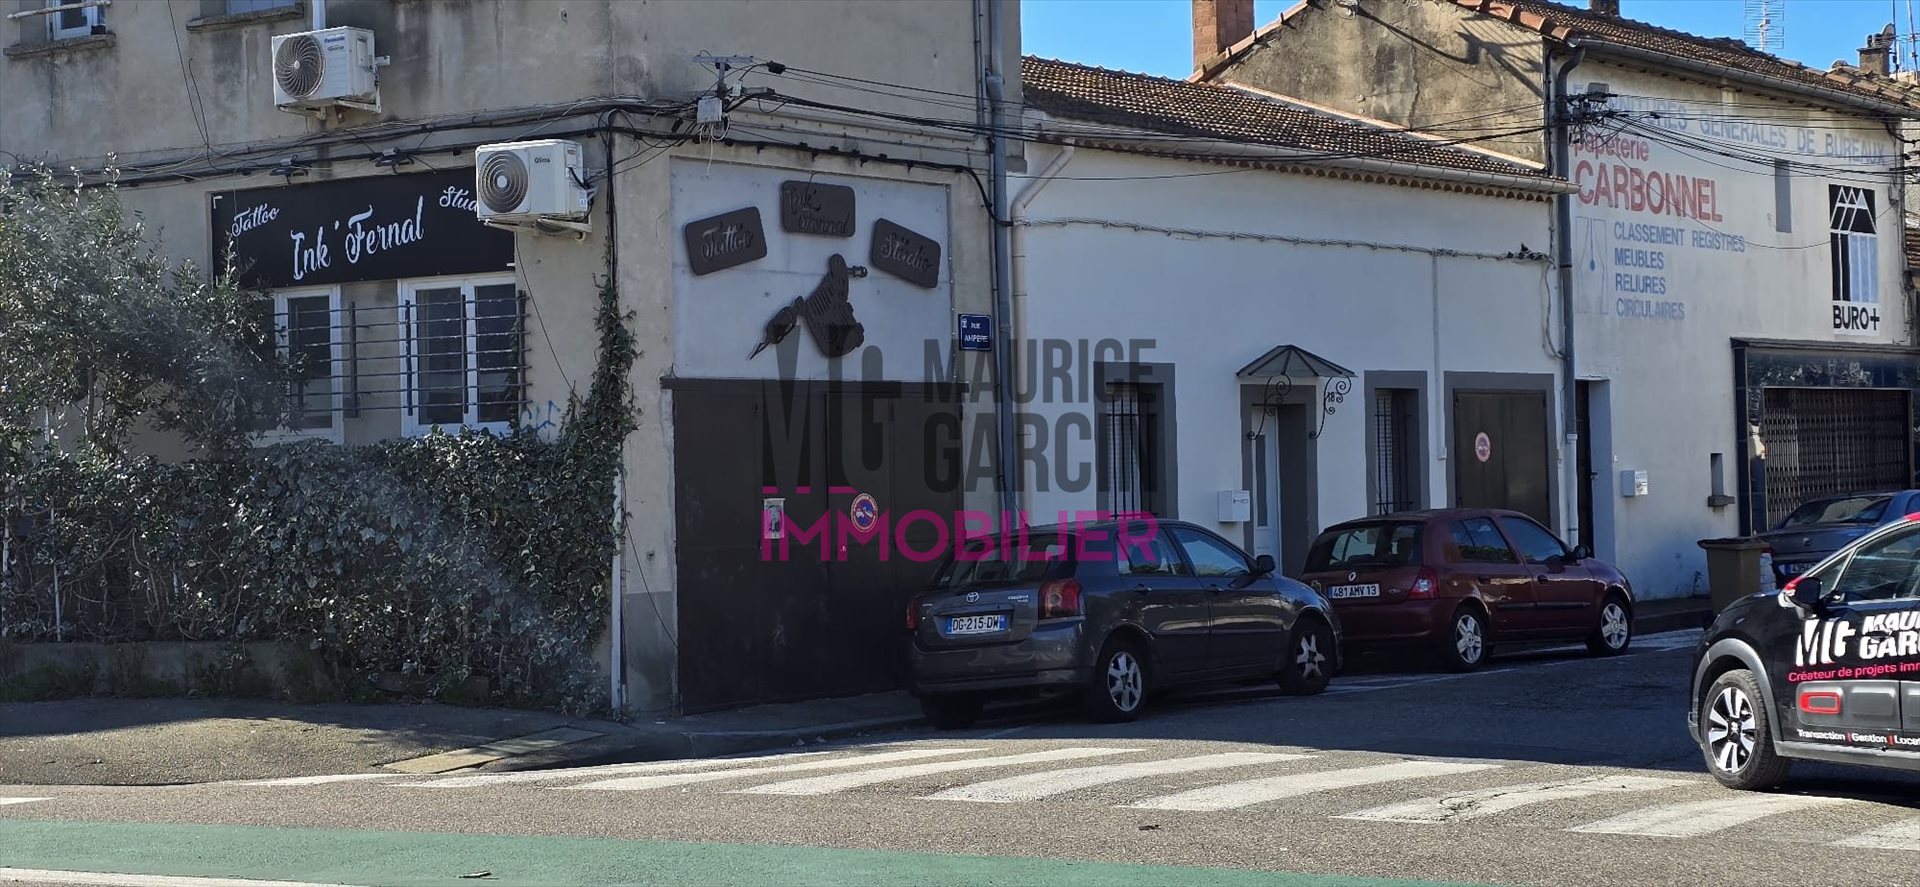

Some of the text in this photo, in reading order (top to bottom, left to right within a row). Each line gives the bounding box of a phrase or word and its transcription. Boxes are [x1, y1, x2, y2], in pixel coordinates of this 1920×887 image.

[1797, 127, 1816, 154] DE
[1826, 133, 1889, 165] BUREAUX
[1575, 160, 1723, 222] CARBONNEL
[231, 203, 280, 237] Tattoo
[345, 196, 424, 264] Fernal
[702, 223, 754, 260] Tattoo
[1613, 221, 1746, 253] CLASSEMENT REGISTRES
[881, 233, 933, 271] Studio
[1614, 247, 1664, 270] MEUBLES
[1615, 272, 1666, 295] RELIURES
[1616, 297, 1685, 321] CIRCULAIRES
[1833, 305, 1880, 331] BURO+
[1333, 586, 1347, 598] 481
[1349, 585, 1365, 597] AMV
[1367, 585, 1377, 596] 13
[952, 616, 999, 631] DG-215-DW
[1862, 611, 1920, 635] MAU
[1859, 630, 1920, 659] GAR
[1788, 669, 1835, 682] Créateur
[1838, 667, 1853, 677] de
[1855, 664, 1897, 678] projets
[1797, 728, 1846, 740] Transaction
[1851, 732, 1887, 743] Gestion
